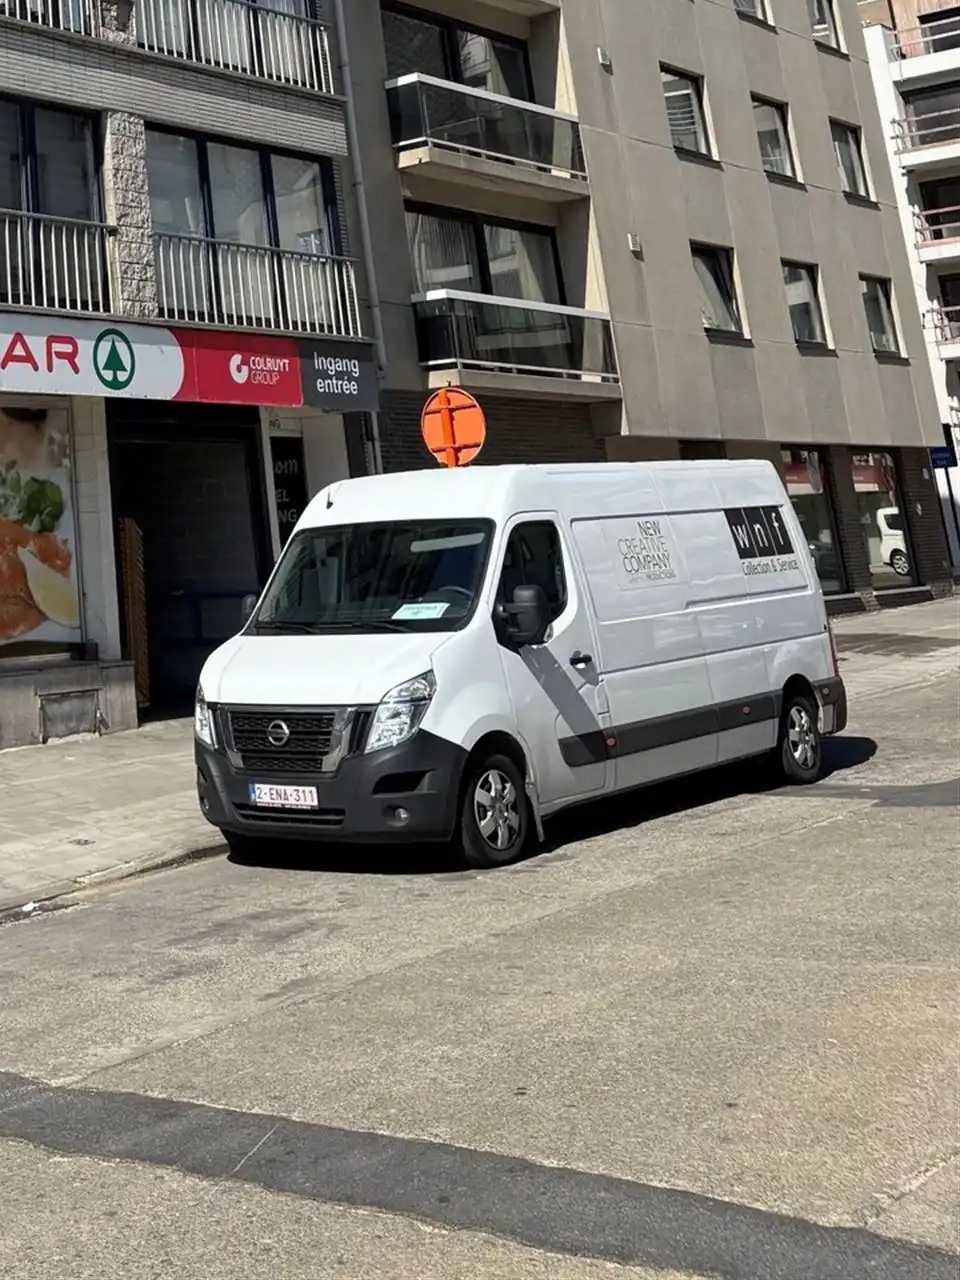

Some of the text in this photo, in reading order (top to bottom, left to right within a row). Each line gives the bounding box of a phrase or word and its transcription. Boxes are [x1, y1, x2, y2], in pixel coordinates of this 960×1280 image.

[249, 356, 290, 372] COLRUYT
[313, 351, 359, 377] Ingang
[251, 371, 280, 385] GROUP
[316, 376, 359, 394] entrée
[637, 520, 661, 536] NEW
[618, 535, 668, 556] CREATIVE
[623, 553, 671, 573] COMPANY
[257, 786, 314, 803] 2-ENA-311
